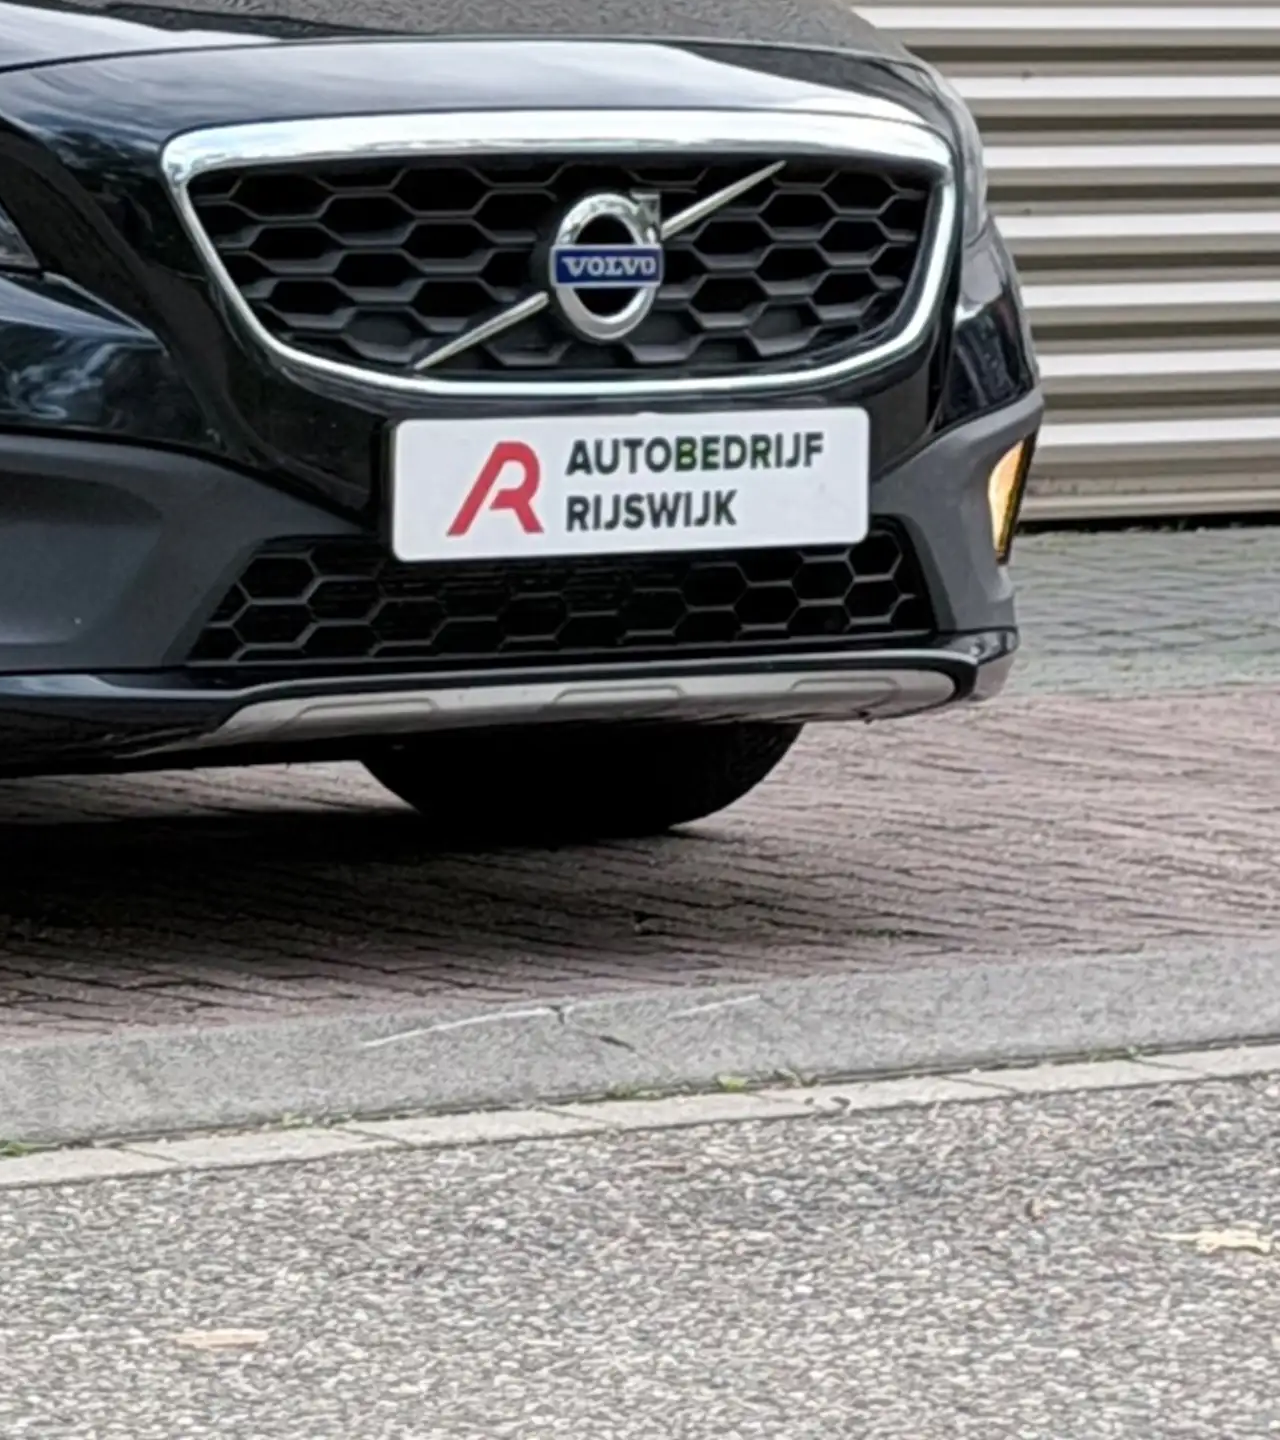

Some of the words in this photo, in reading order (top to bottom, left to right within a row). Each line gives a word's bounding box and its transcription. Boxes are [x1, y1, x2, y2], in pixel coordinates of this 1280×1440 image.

[561, 255, 657, 278] VOLVO
[565, 431, 825, 476] AUTOBEDRIJF
[565, 489, 738, 533] RIJSWIJK
